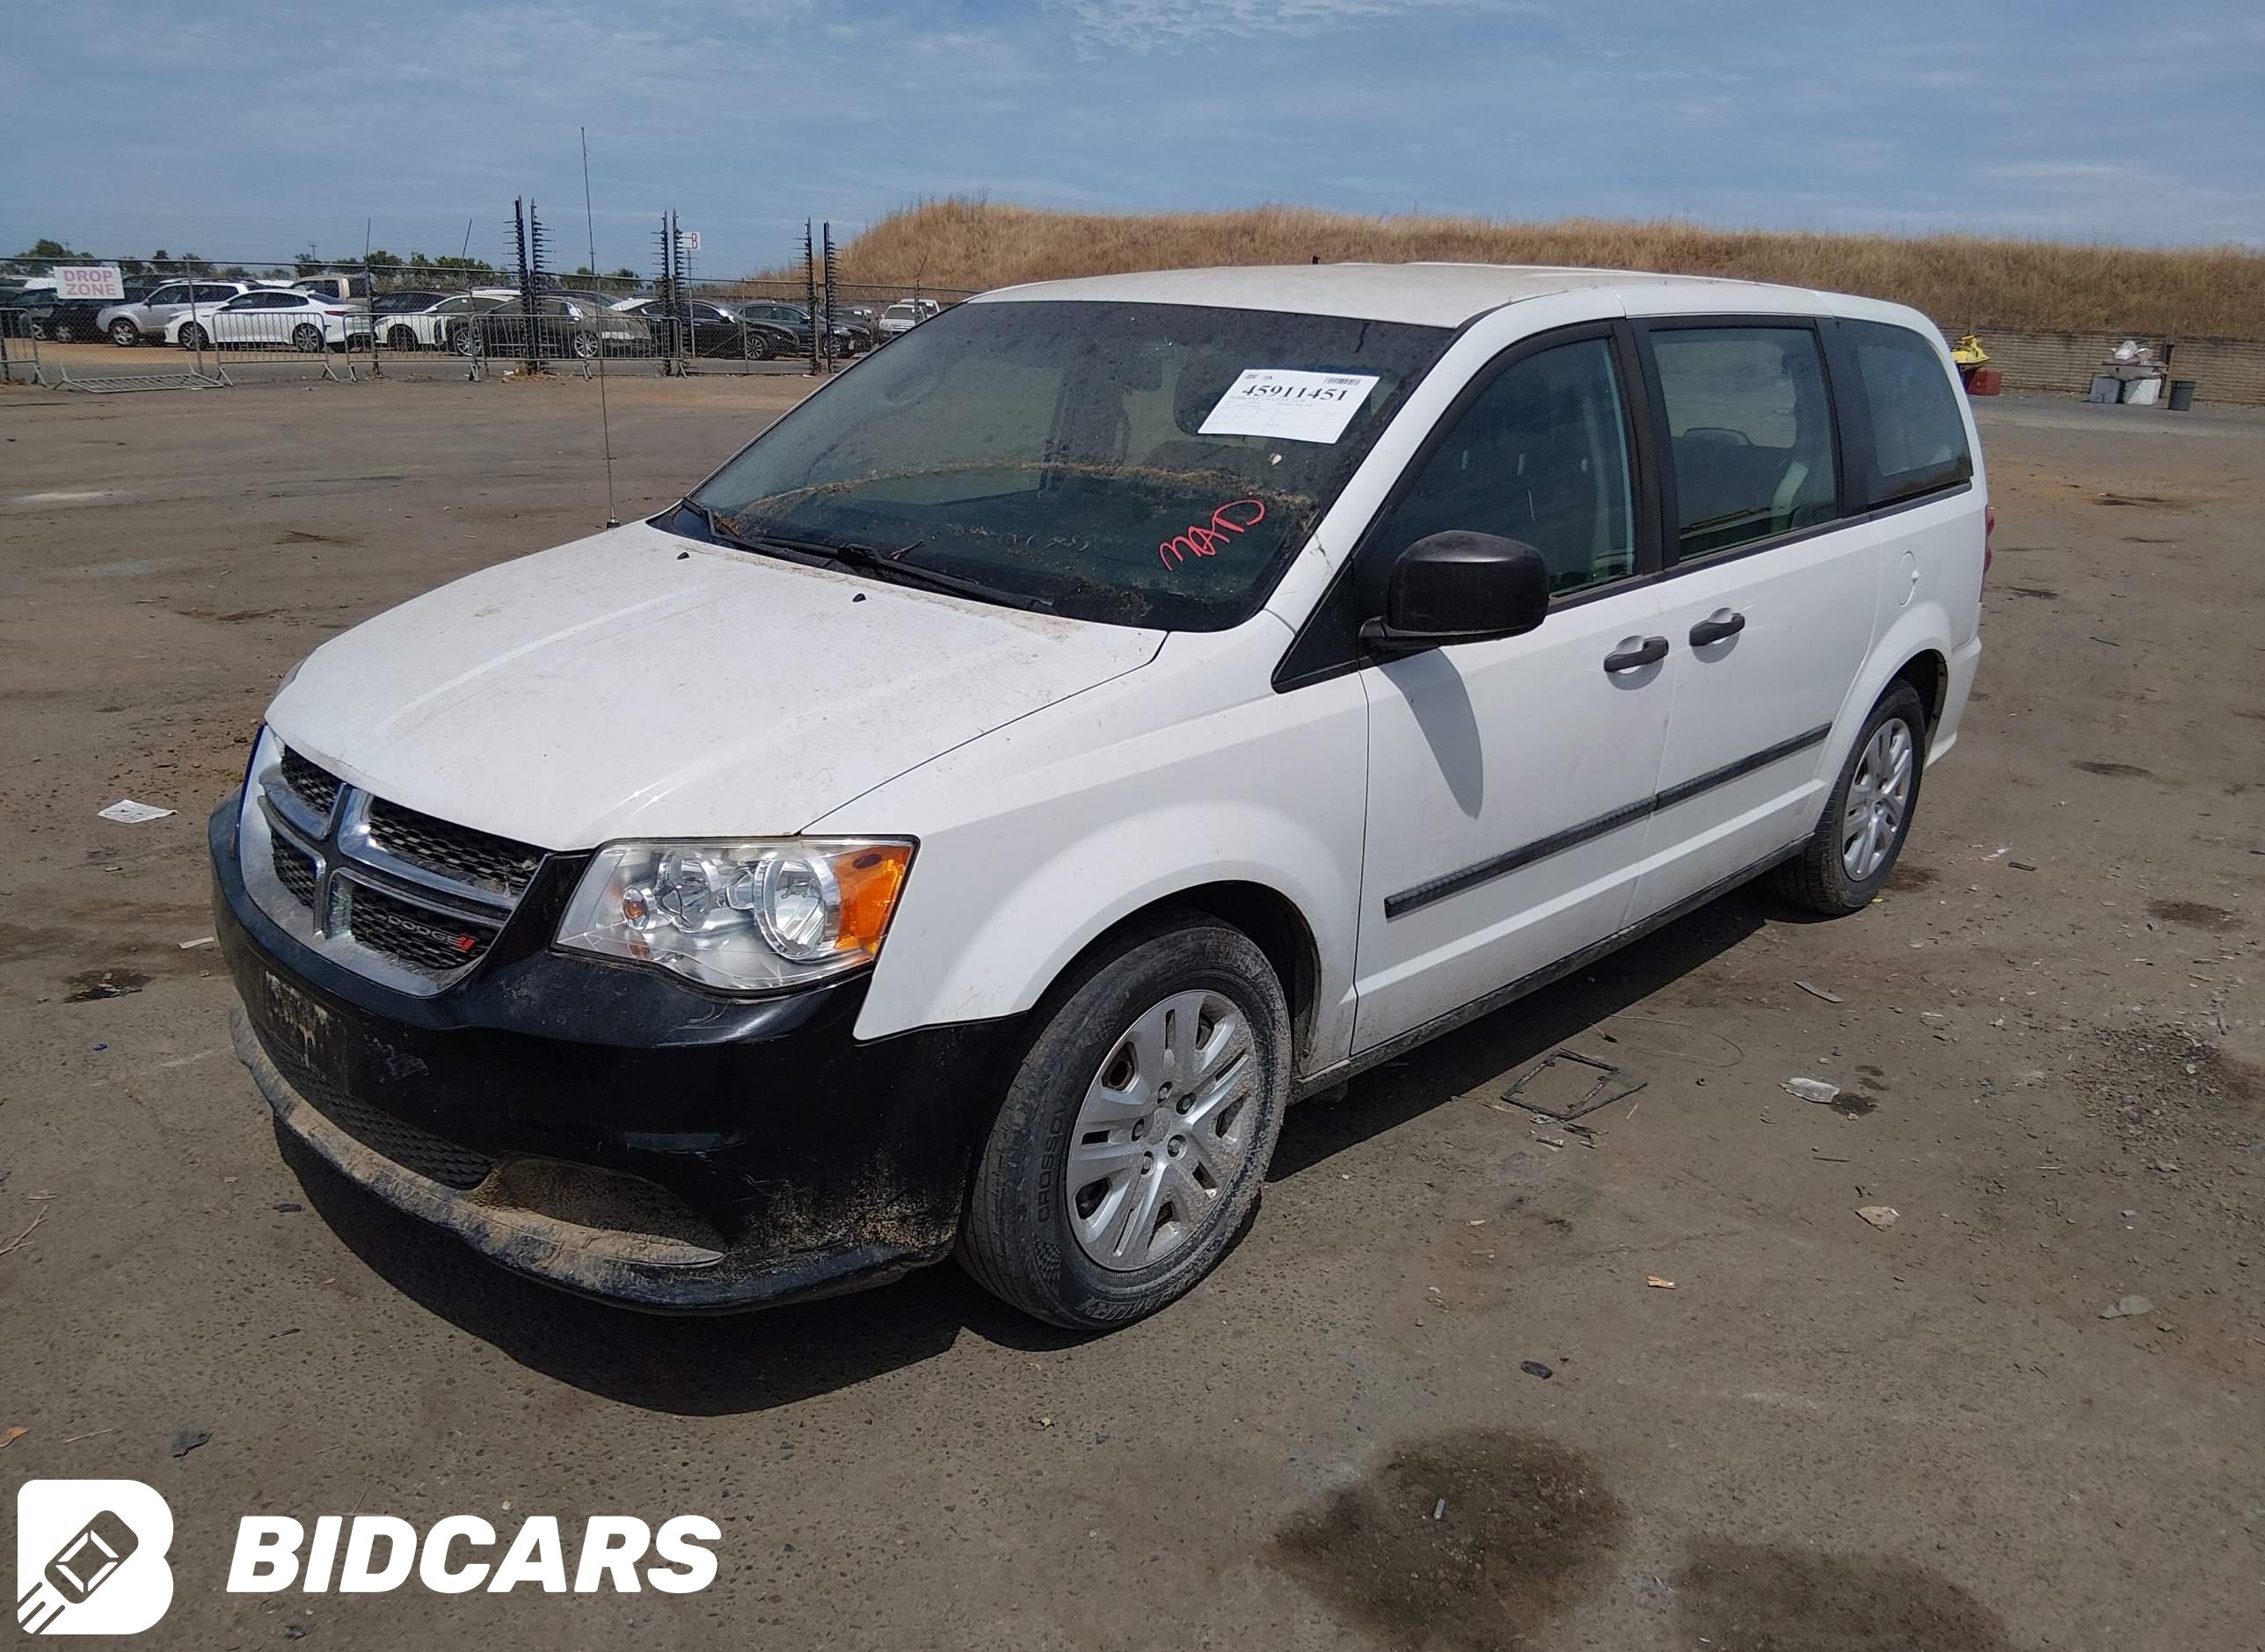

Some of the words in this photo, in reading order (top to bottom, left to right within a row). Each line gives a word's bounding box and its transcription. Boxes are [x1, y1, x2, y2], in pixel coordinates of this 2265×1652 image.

[691, 232, 698, 250] B
[62, 270, 113, 282] DROP
[66, 283, 117, 295] ZONE
[1242, 384, 1349, 402] 45911451
[387, 914, 461, 947] DODGE
